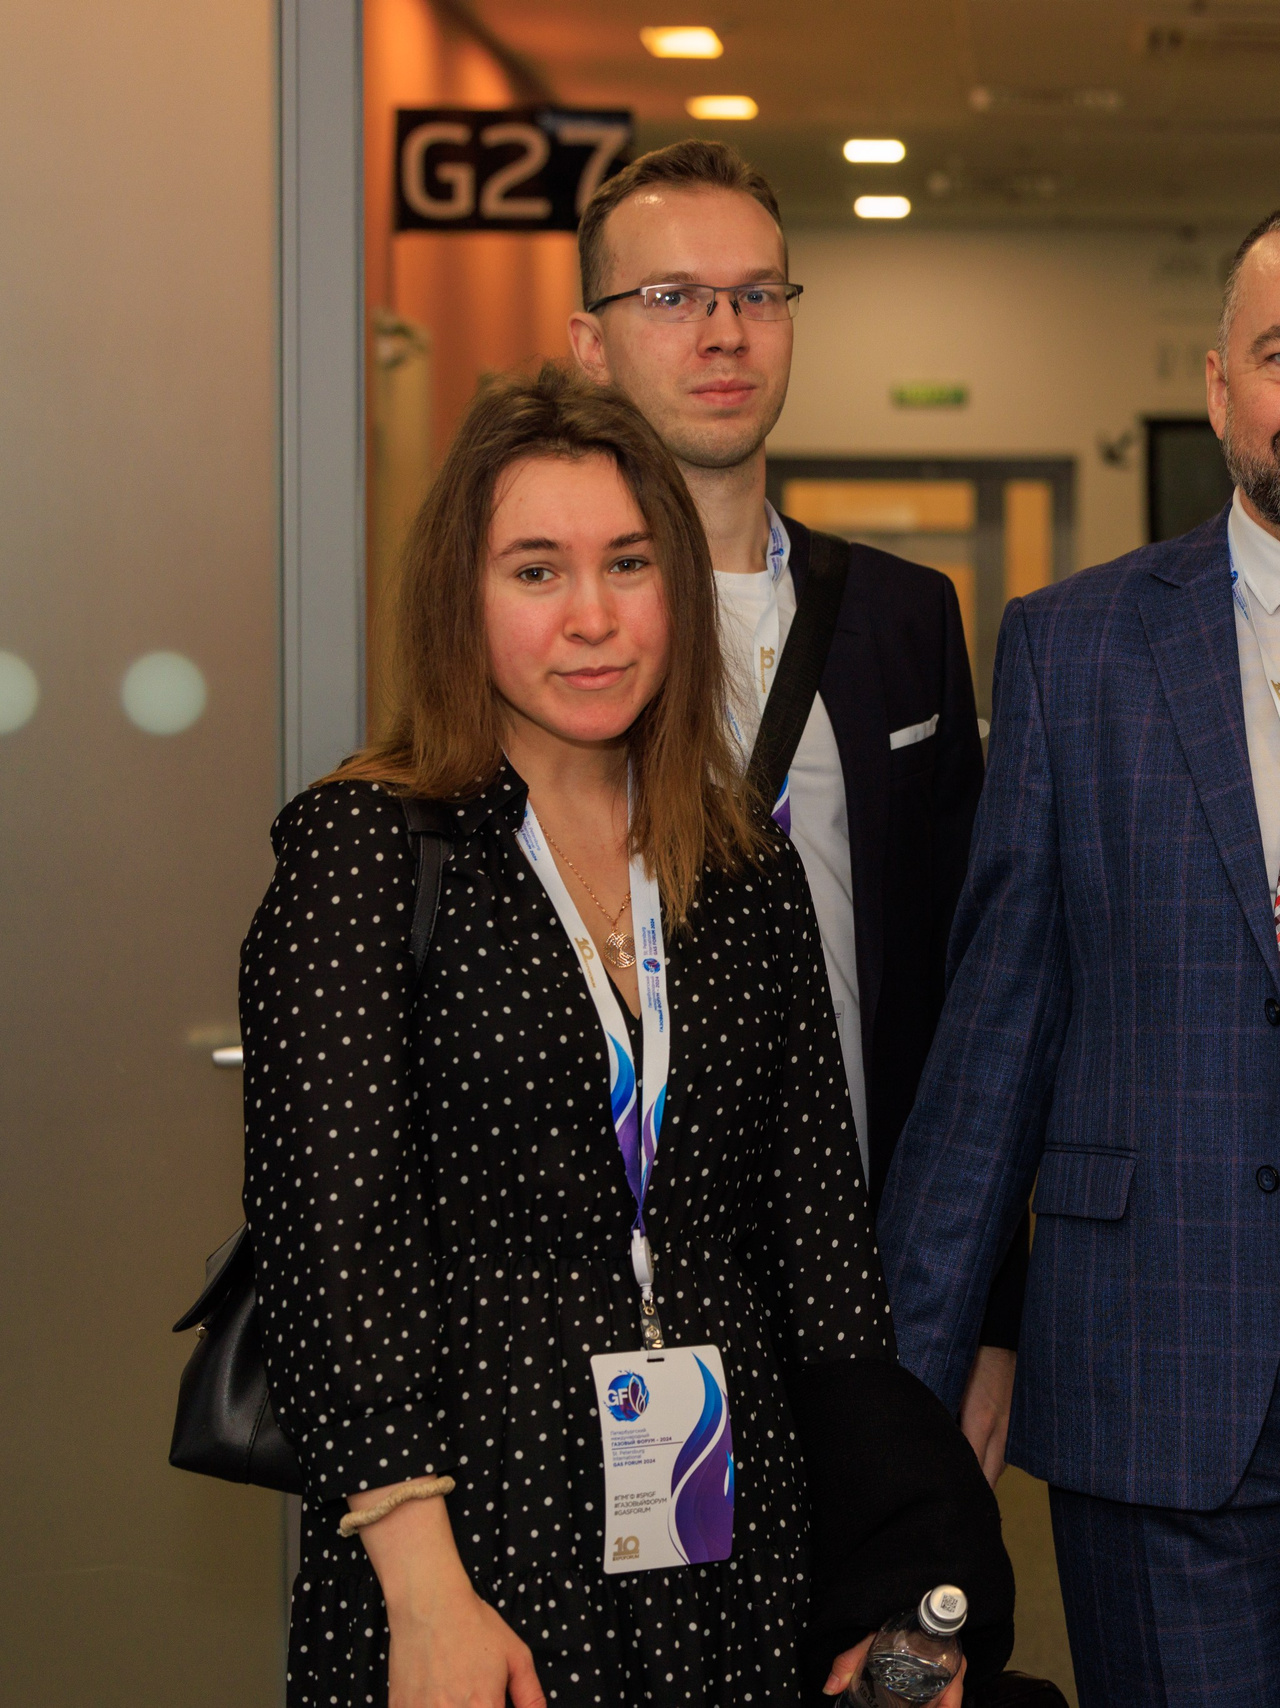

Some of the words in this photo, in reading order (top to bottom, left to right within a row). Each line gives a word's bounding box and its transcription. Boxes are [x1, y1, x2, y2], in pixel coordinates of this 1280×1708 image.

[401, 121, 631, 220] G27
[606, 1387, 629, 1407] GF
[613, 1535, 640, 1555] 10
